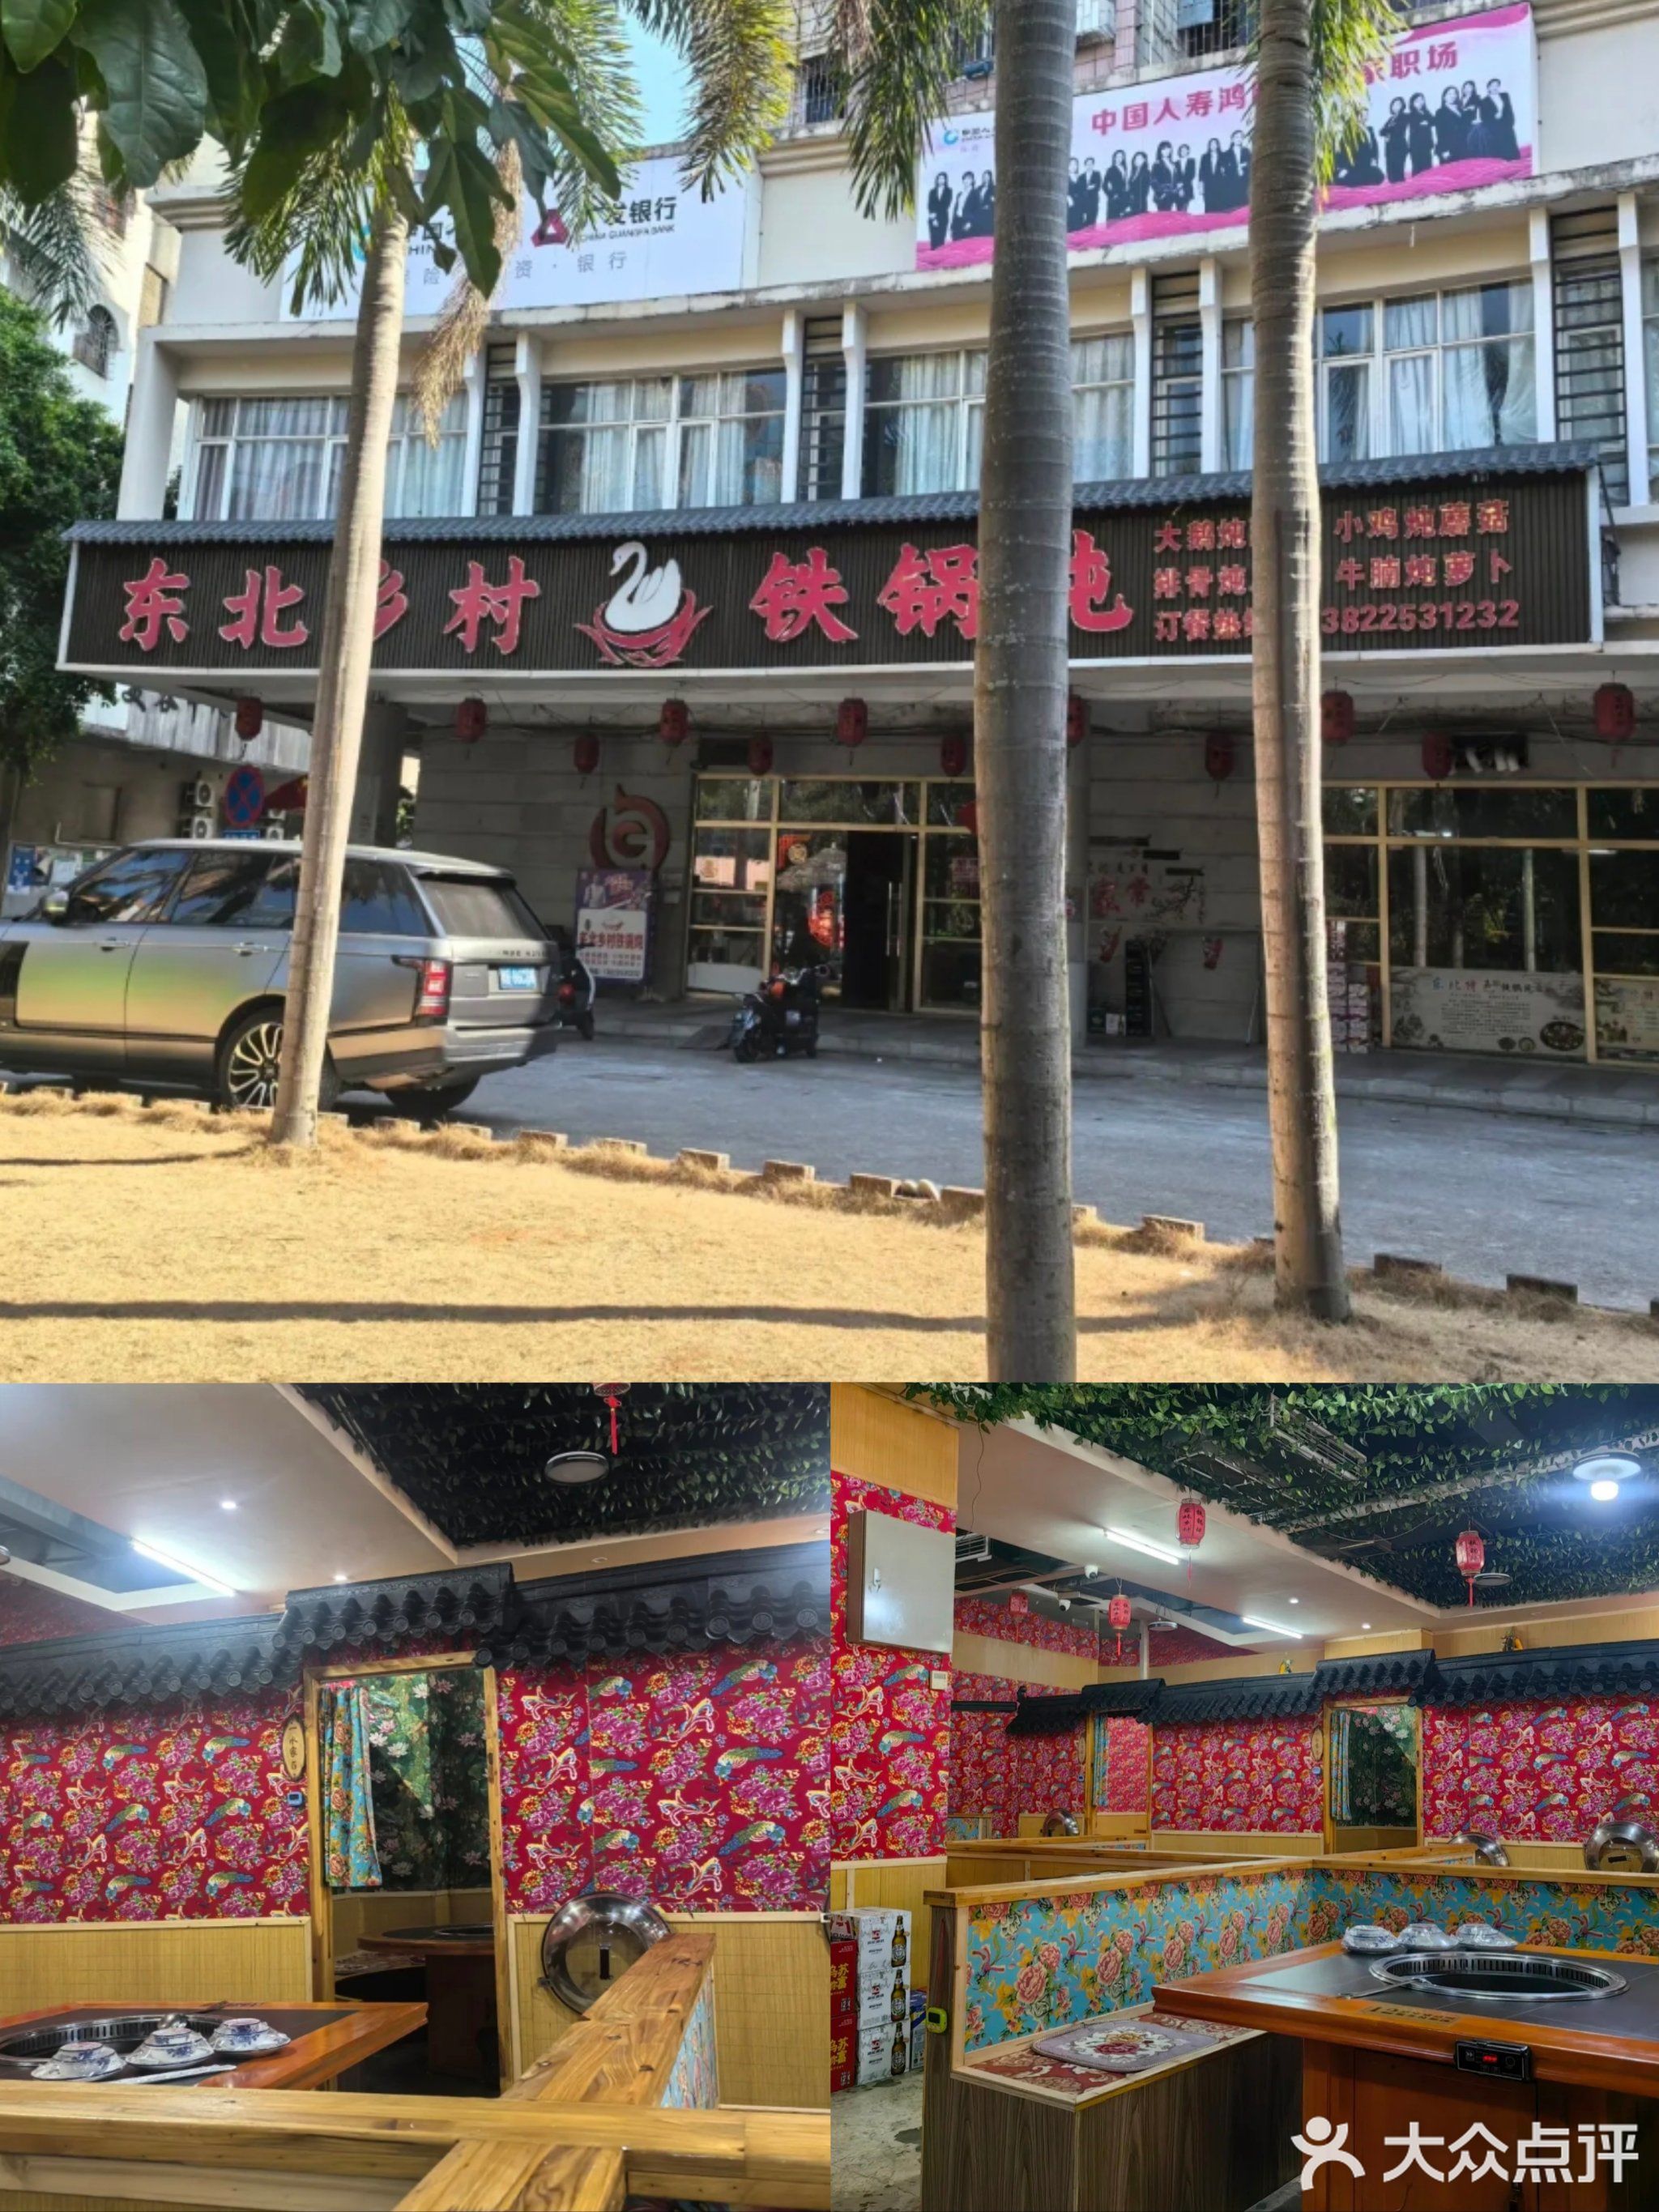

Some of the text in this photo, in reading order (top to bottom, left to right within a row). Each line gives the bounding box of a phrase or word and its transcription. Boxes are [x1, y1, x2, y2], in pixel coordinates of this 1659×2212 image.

[1092, 80, 1262, 136] 中国人寿鸿
[594, 196, 677, 226] 发银行
[407, 244, 435, 256] HIN
[1154, 517, 1252, 552] 大鹅炖
[1333, 499, 1510, 544] 小鸡炖蘑菇
[1154, 565, 1252, 599] 排骨炖
[1335, 548, 1513, 591] 牛腩炖萝卜
[1320, 599, 1520, 634] 3822531232
